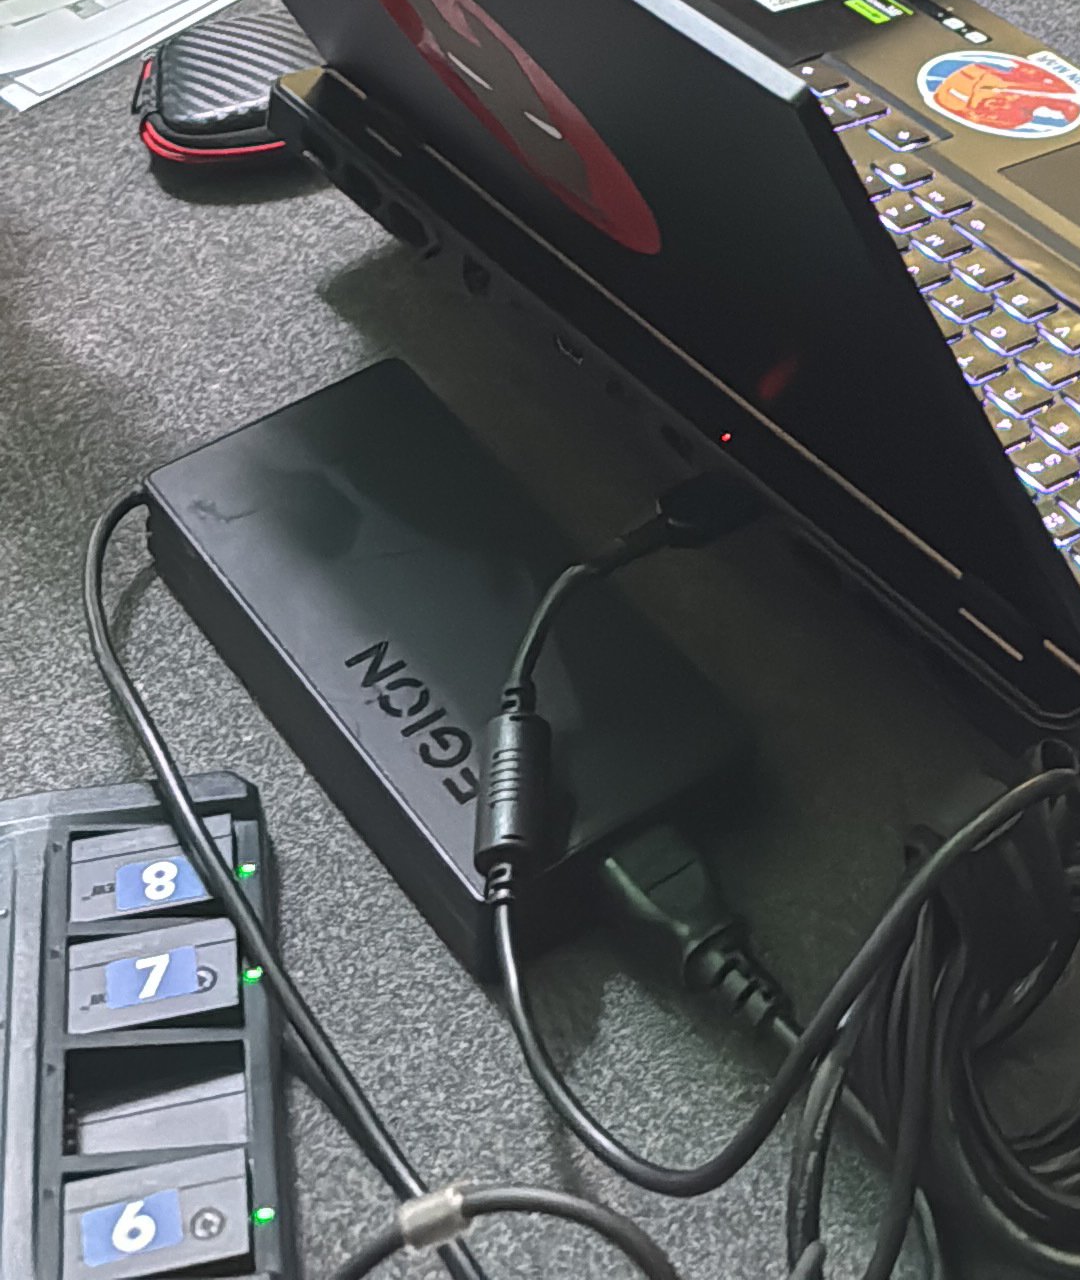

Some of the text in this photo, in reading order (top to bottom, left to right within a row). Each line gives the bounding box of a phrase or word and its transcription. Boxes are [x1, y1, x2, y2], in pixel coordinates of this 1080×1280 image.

[344, 640, 481, 806] EGION
[141, 861, 178, 901] 8
[135, 952, 170, 1000] 7
[110, 1199, 157, 1254] 6
